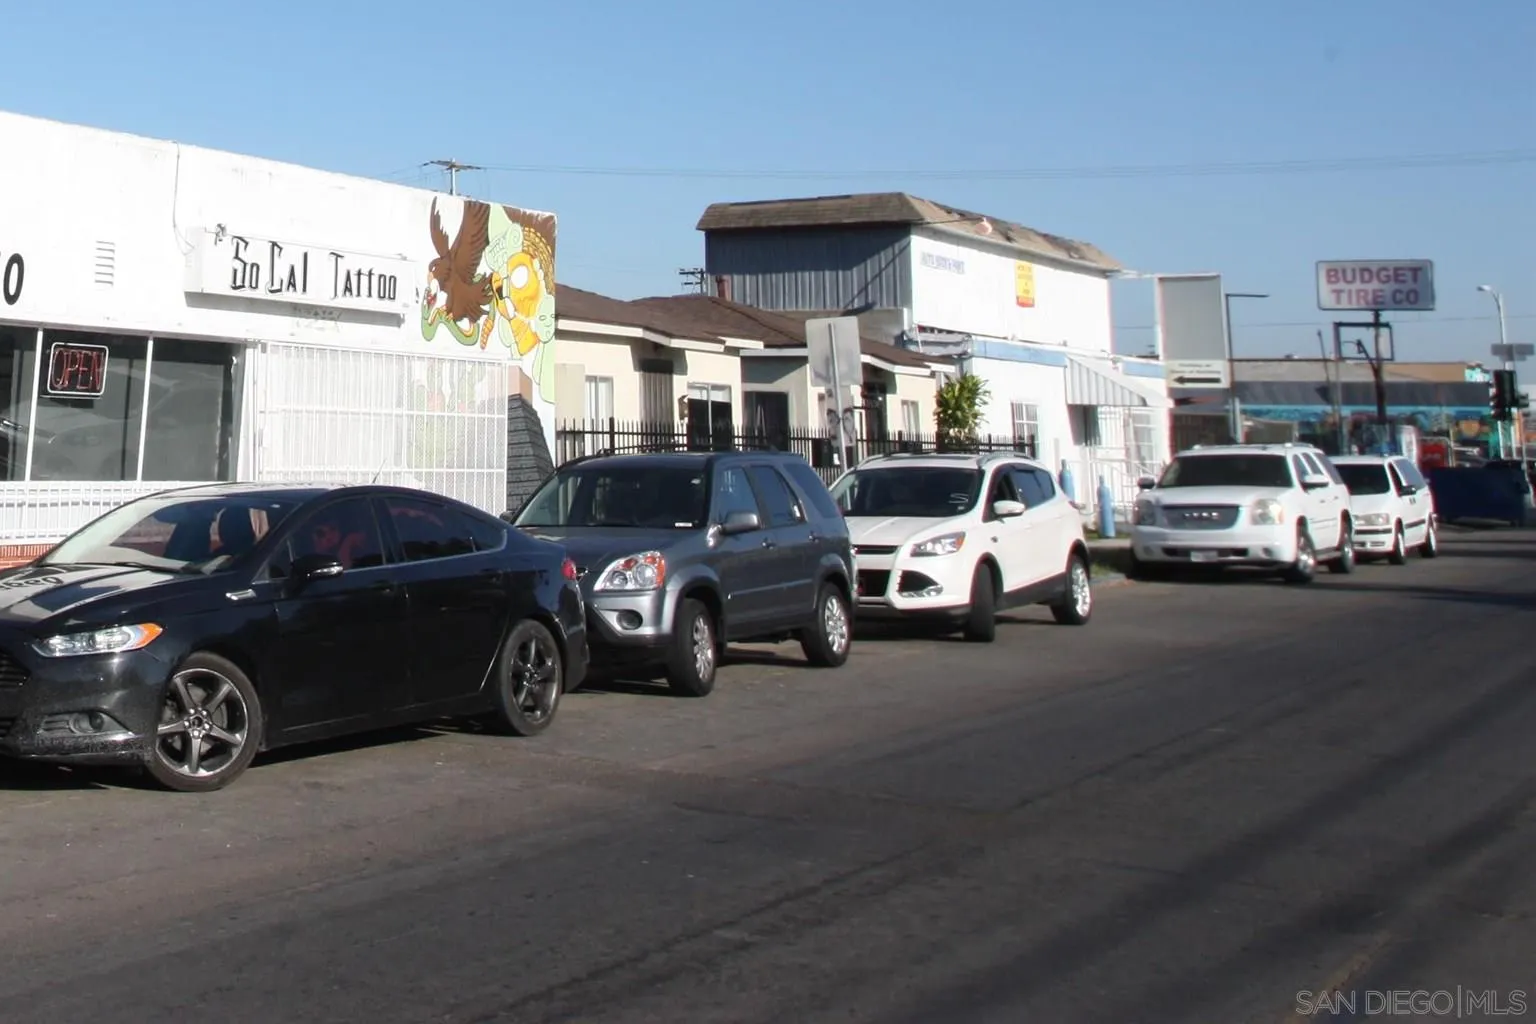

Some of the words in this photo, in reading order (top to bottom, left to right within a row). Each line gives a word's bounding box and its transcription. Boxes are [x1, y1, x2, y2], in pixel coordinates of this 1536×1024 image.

[1325, 266, 1423, 285] BUDGET
[1330, 288, 1386, 306] TIRE
[1391, 288, 1420, 306] CO
[52, 347, 104, 390] OPEN
